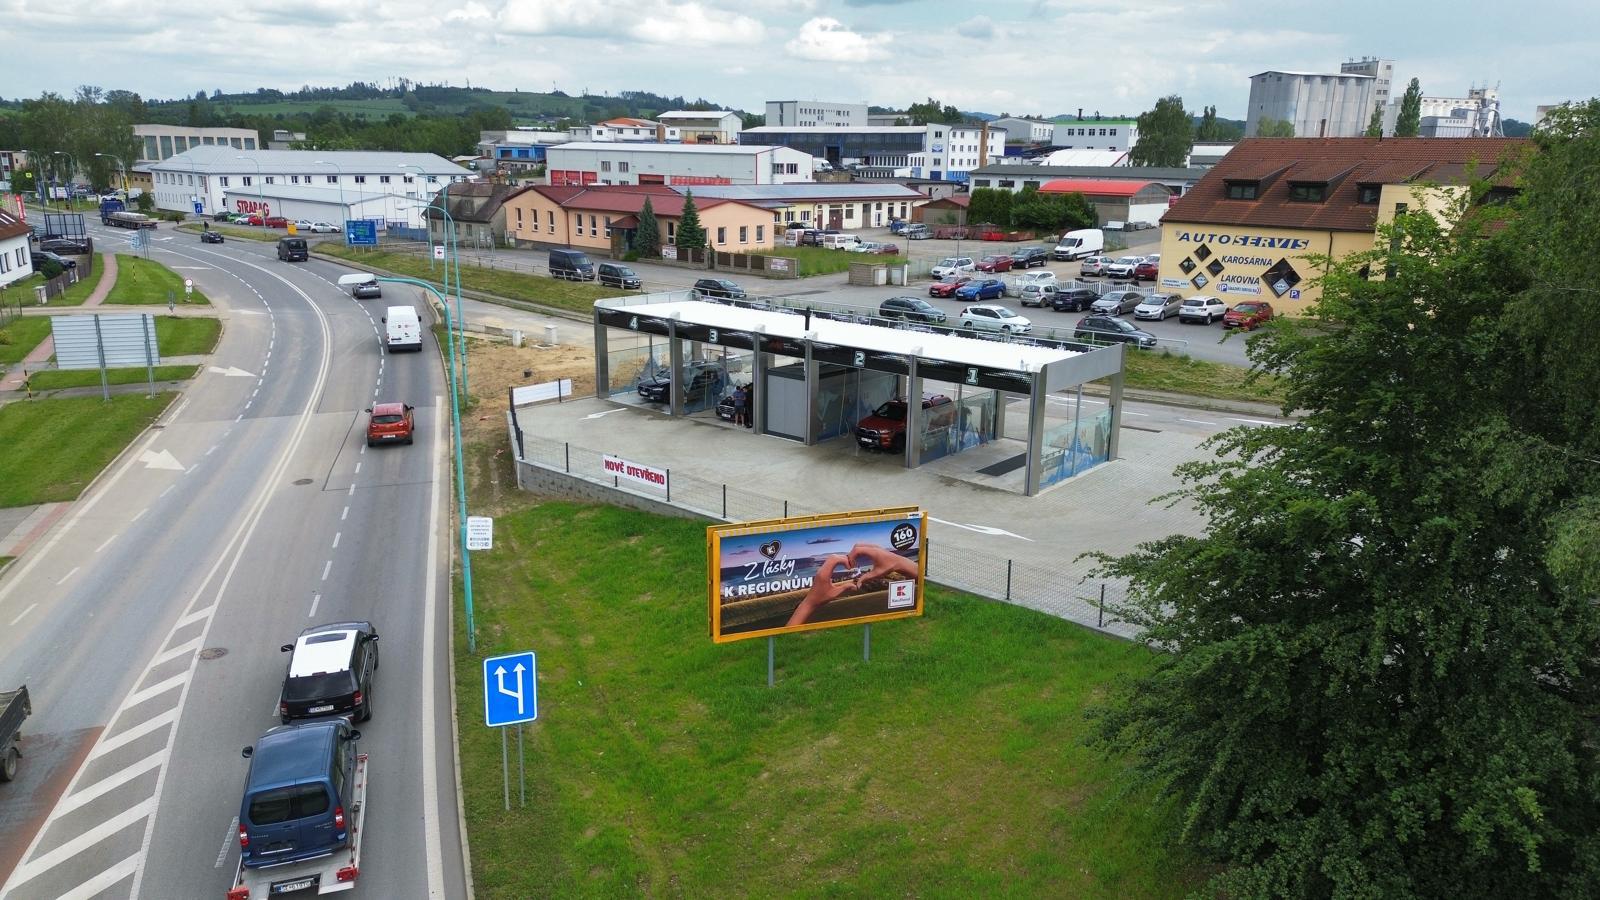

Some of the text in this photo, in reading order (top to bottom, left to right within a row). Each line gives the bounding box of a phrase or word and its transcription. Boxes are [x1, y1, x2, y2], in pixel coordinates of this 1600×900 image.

[1178, 232, 1309, 249] AUTOSERVIS
[1221, 255, 1273, 267] KAROSÁRNA
[1221, 274, 1260, 285] LAKOVNA
[629, 316, 638, 330] 4
[709, 329, 718, 343] 3
[854, 351, 865, 367] 2
[966, 367, 979, 385] 1
[604, 460, 665, 485] NOVĚ OTEVŘENO
[893, 527, 913, 542] 160
[744, 554, 796, 581] Z lásky
[724, 576, 813, 598] K REGIONŮM
